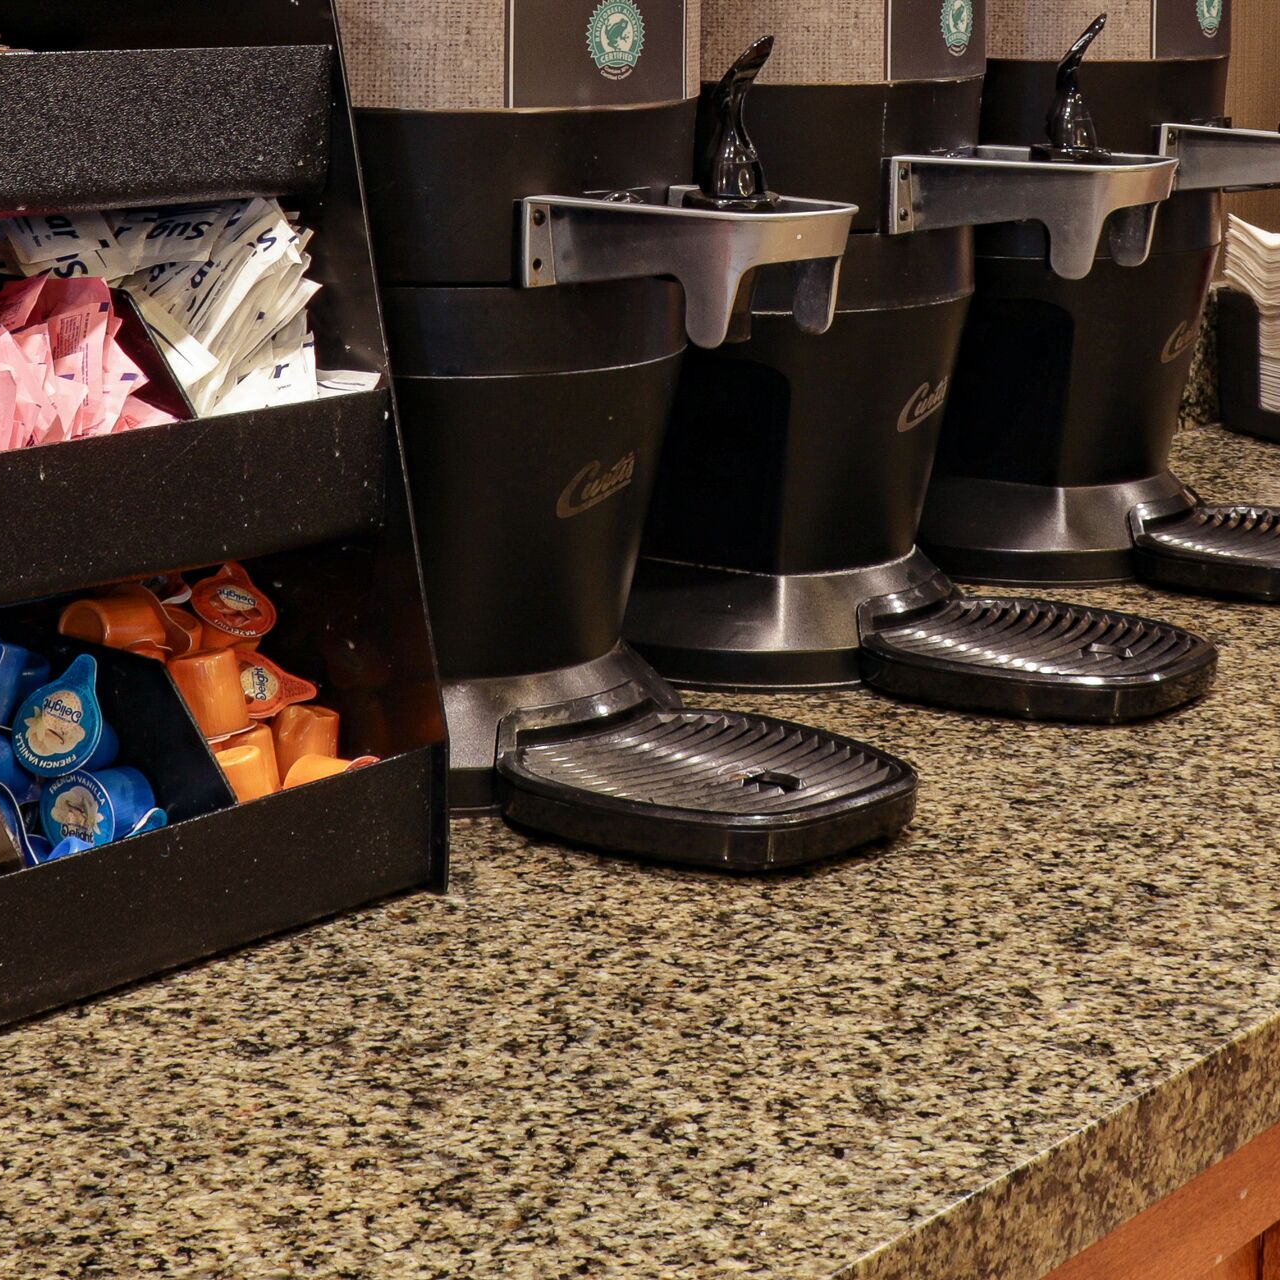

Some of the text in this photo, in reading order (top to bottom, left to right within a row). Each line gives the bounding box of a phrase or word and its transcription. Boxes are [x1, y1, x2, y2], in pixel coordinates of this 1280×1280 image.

[600, 53, 633, 63] CERTIFIED
[217, 589, 257, 606] Delight
[43, 697, 82, 723] Delight
[15, 732, 77, 769] FRENCH VANILLA
[49, 774, 107, 805] FRENCH VANILLA
[61, 824, 95, 844] Delight
